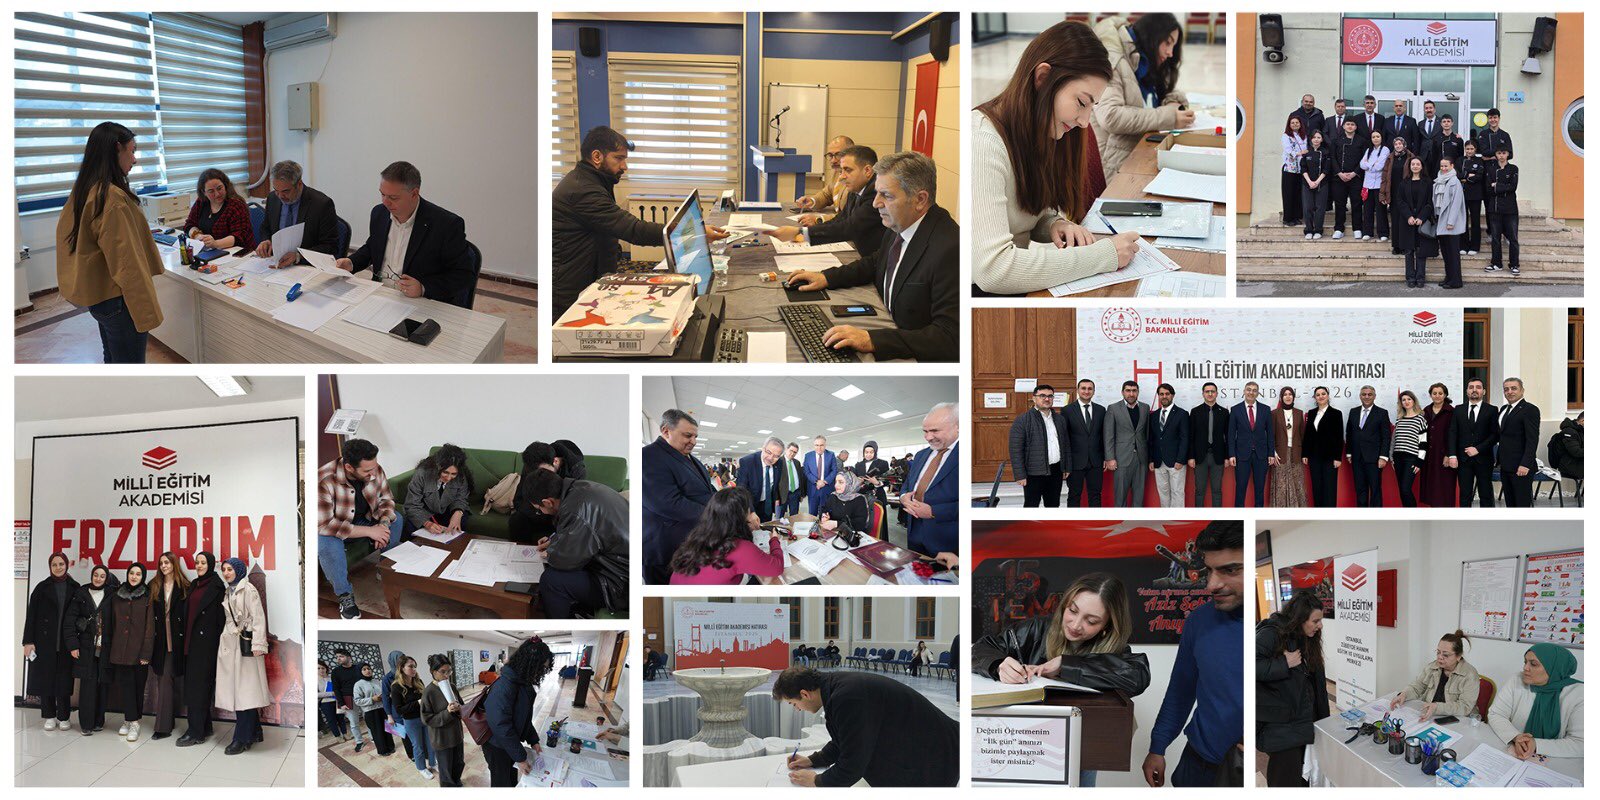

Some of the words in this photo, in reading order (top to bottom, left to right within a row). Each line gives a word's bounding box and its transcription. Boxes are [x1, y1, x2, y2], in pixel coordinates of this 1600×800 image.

[1404, 36, 1432, 47] MİLLÎ
[1434, 36, 1469, 47] EĞİTİM
[1408, 46, 1465, 57] AKADEMİSİ
[1145, 317, 1159, 325] T.C.
[1183, 317, 1210, 326] EĞİTİM
[1145, 326, 1188, 334] BAKANLIĞI
[1175, 360, 1211, 379] MİLLÎ
[1214, 360, 1257, 379] EĞİTİM
[1260, 360, 1327, 379] AKADEMİSİ
[1331, 363, 1386, 379] HATIRASI
[113, 474, 153, 490] MİLLÎ
[157, 473, 211, 489] EĞİTİM
[119, 490, 205, 507] AKADEMİSİ
[53, 515, 276, 570] ERZURUM
[1144, 595, 1177, 613] Aziz
[1352, 598, 1373, 611] EĞİTİM
[1340, 610, 1371, 623] AKADEMİSİ
[976, 727, 1003, 735] Değerli
[1004, 727, 1050, 736] Öğretmenim
[981, 747, 1006, 755] bizimle
[1007, 748, 1045, 757] paylaşmak
[990, 757, 1005, 765] ister
[1007, 758, 1036, 766] misiniz?
